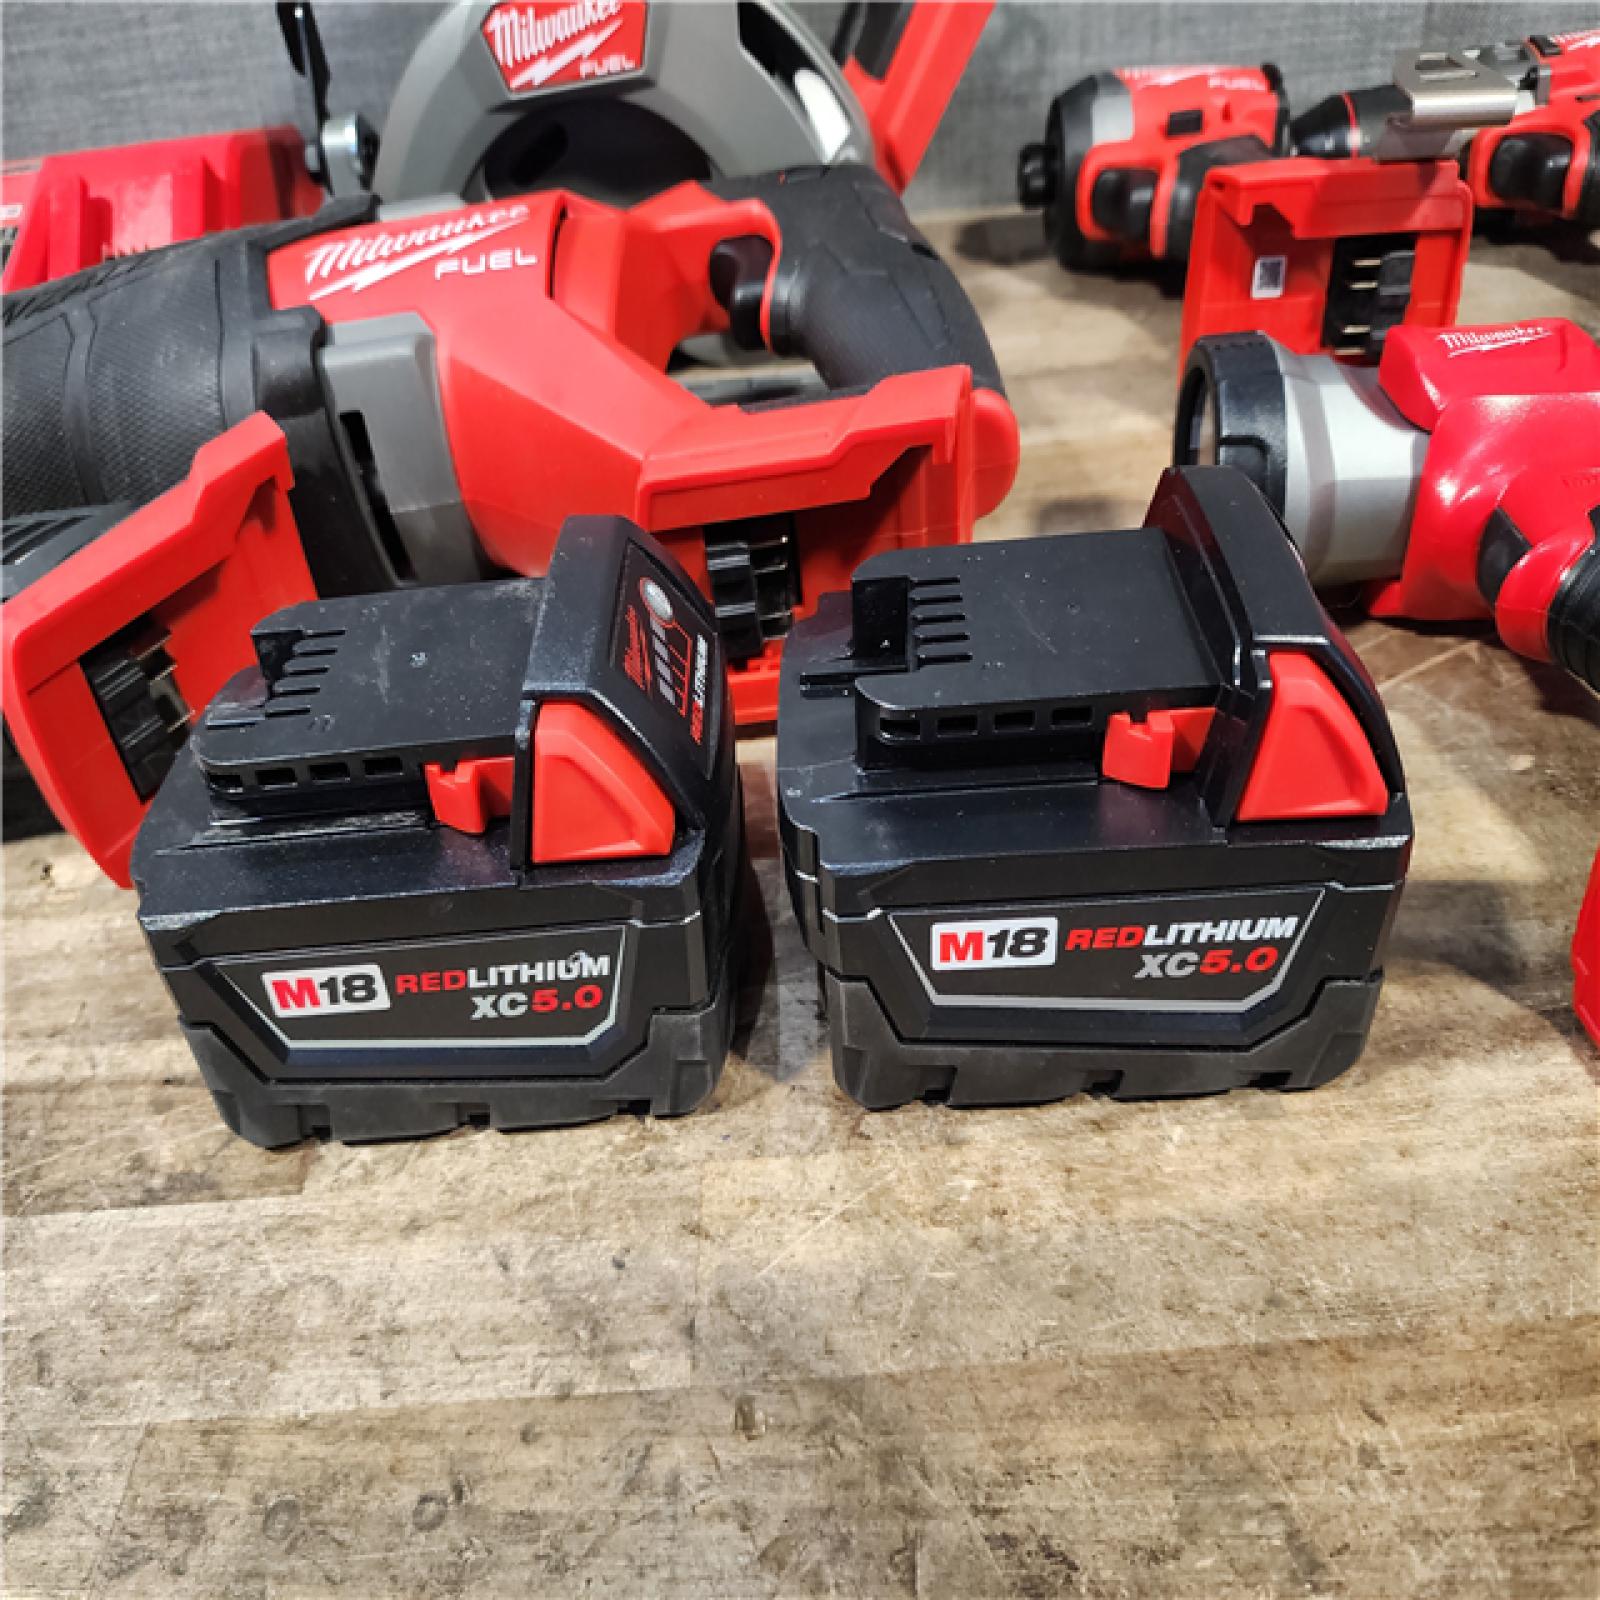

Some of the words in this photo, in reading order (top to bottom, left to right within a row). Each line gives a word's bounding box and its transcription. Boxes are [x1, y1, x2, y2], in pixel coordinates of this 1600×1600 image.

[305, 204, 529, 283] Milwaukee
[434, 247, 538, 280] FUEL
[1436, 326, 1545, 349] Milwaukee
[938, 926, 1050, 963] M18
[1065, 916, 1299, 951] REDLITHIUM
[271, 973, 379, 1010] M18
[395, 953, 611, 995] REDLITHIUM
